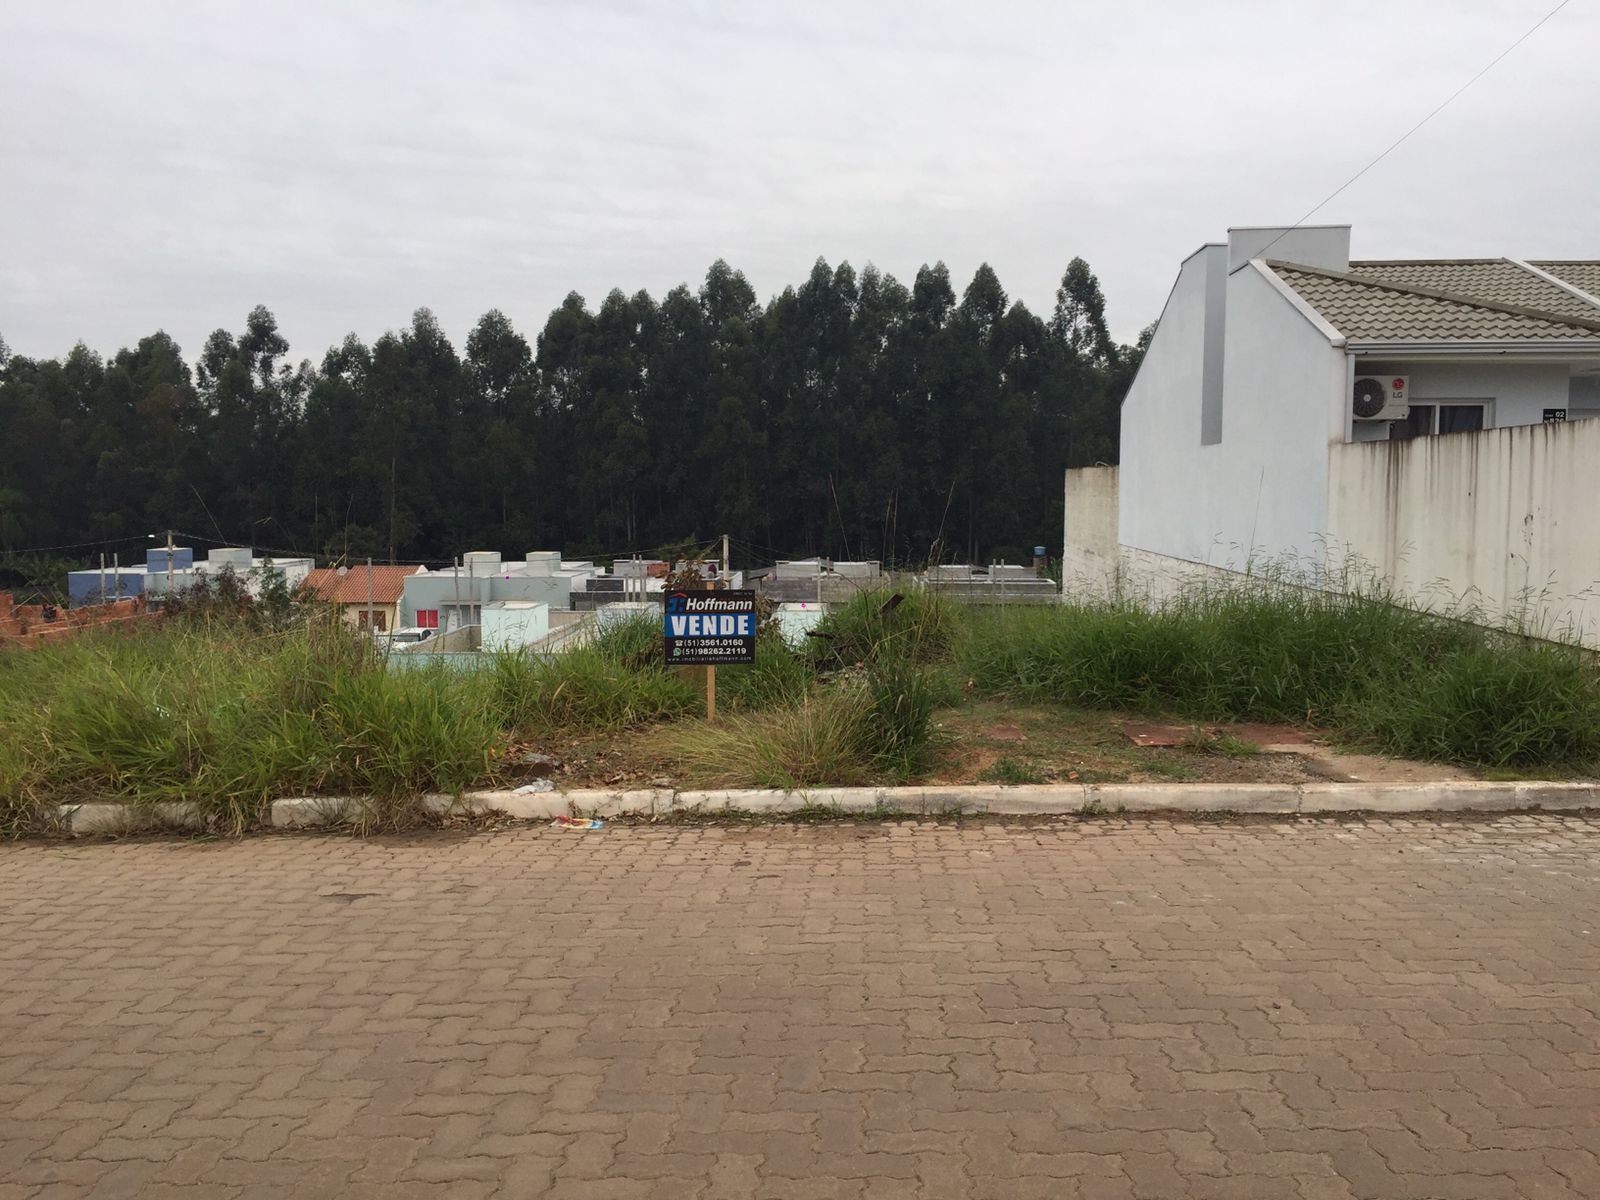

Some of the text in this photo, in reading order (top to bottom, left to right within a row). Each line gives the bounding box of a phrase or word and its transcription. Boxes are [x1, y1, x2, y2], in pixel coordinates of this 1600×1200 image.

[1392, 391, 1403, 399] LG
[685, 597, 753, 611] Hoffmann
[671, 615, 749, 636] VENDE
